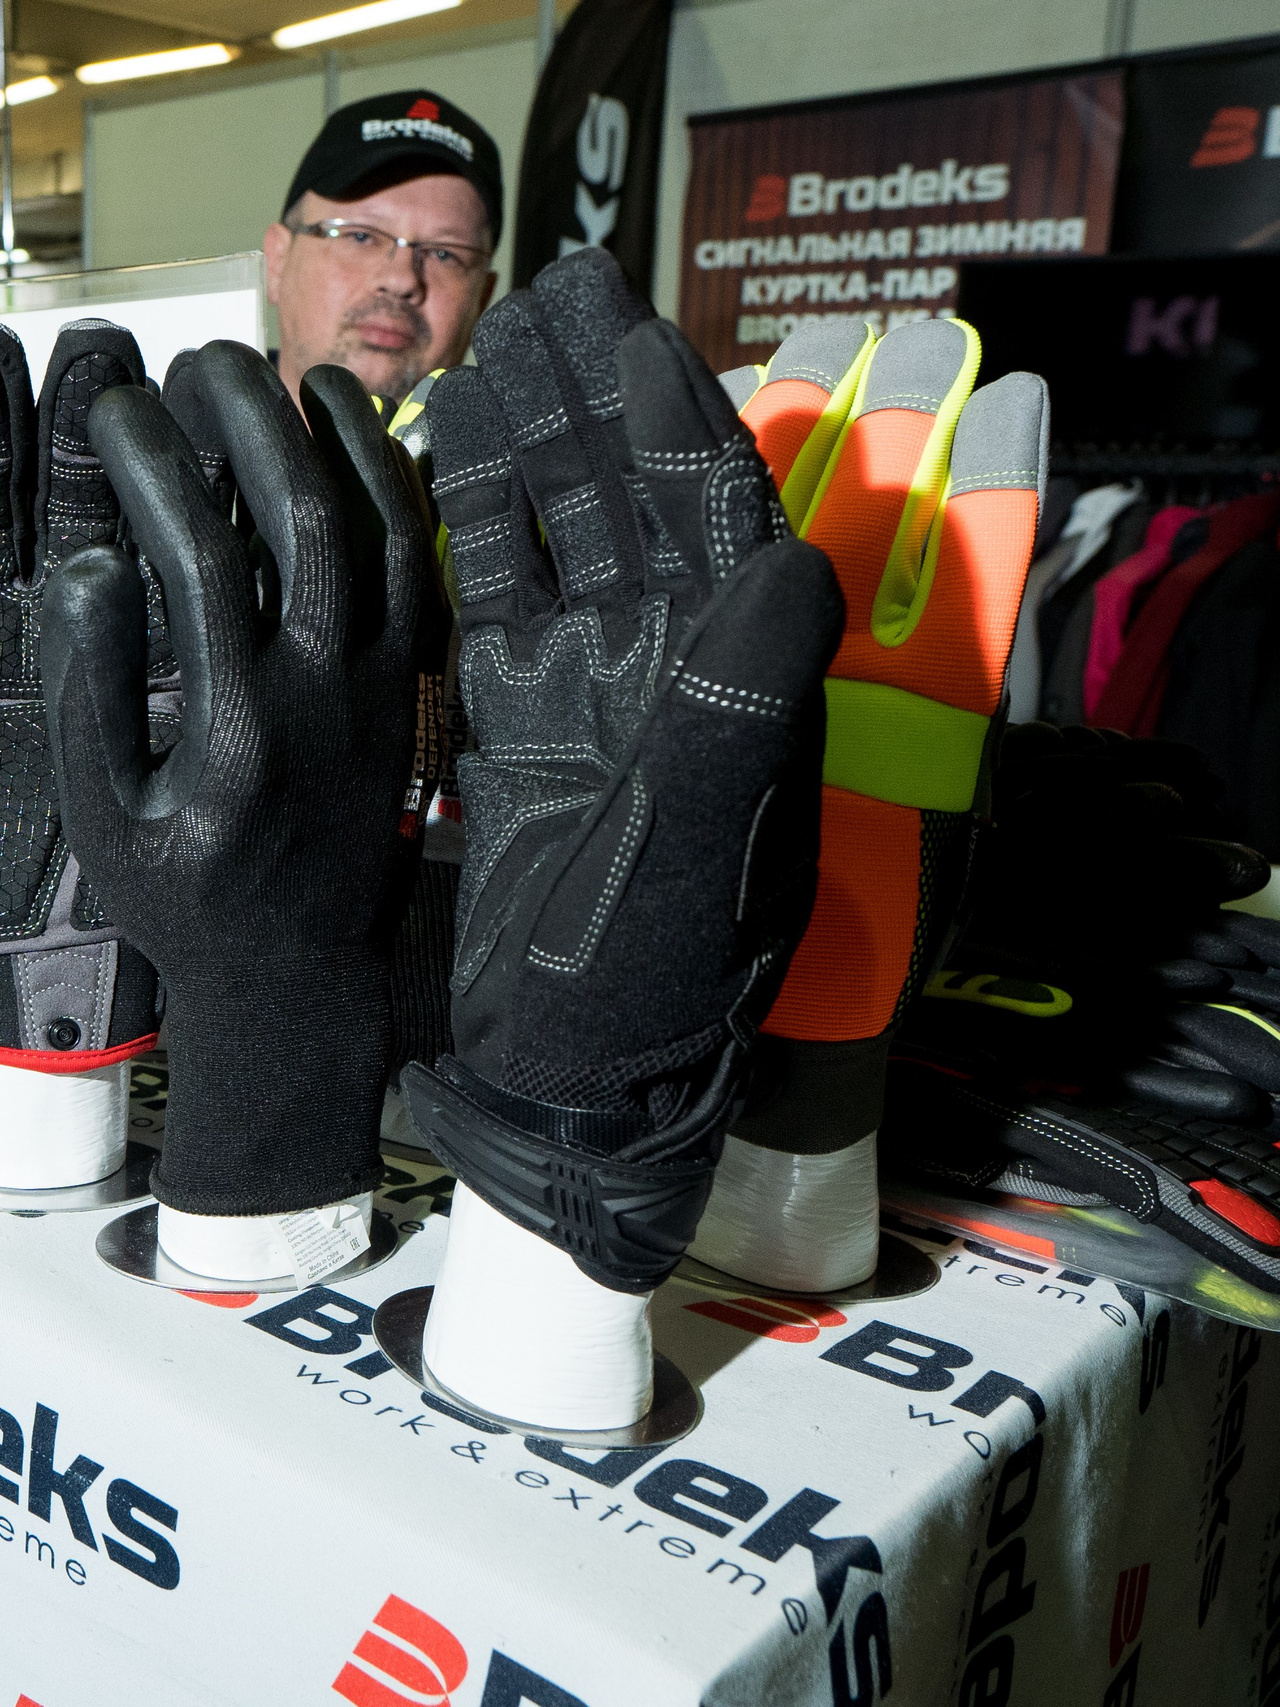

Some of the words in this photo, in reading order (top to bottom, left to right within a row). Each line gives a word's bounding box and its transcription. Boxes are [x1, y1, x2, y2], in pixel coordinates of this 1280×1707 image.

[786, 159, 1010, 219] Brodeks
[694, 226, 911, 270] СИГНАЛЬНАЯ
[915, 216, 1087, 259] ЗИМНЯЯ
[404, 672, 426, 811] Brodeks
[426, 674, 437, 780] DEFENDER
[297, 1363, 436, 1436] work
[450, 1440, 486, 1464] &
[514, 1467, 808, 1637] extreme
